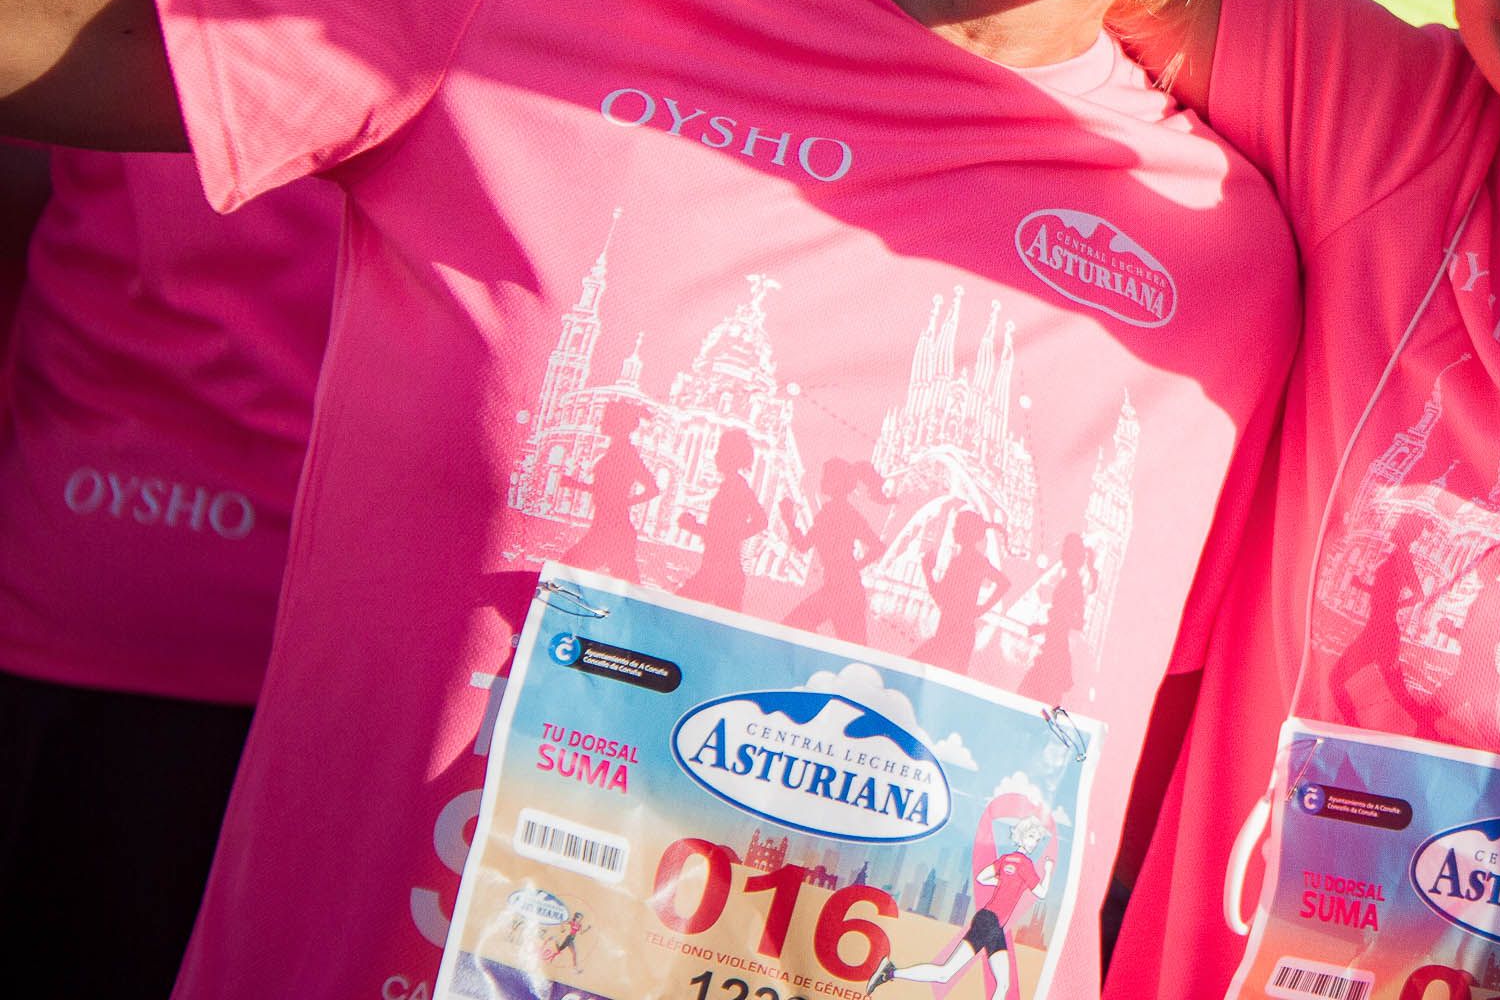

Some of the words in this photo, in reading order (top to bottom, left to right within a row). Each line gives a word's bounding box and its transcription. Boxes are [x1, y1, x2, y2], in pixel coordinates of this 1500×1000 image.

[601, 88, 852, 182] OYSHO
[1025, 224, 1166, 320] ASTURIANA
[1056, 231, 1107, 263] CENTRAL
[64, 466, 255, 540] OYSHO
[536, 743, 628, 794] SUMA
[543, 722, 565, 743] TU
[568, 730, 638, 764] DORSAL
[689, 717, 929, 826] ASTURIANA
[746, 722, 834, 757] CENTRAL
[845, 751, 932, 785] LECHERA
[653, 838, 899, 983] 016
[1300, 890, 1379, 932] SUMA
[1303, 871, 1321, 890] TU
[1324, 874, 1386, 902] DORSAL
[793, 975, 813, 989] DE
